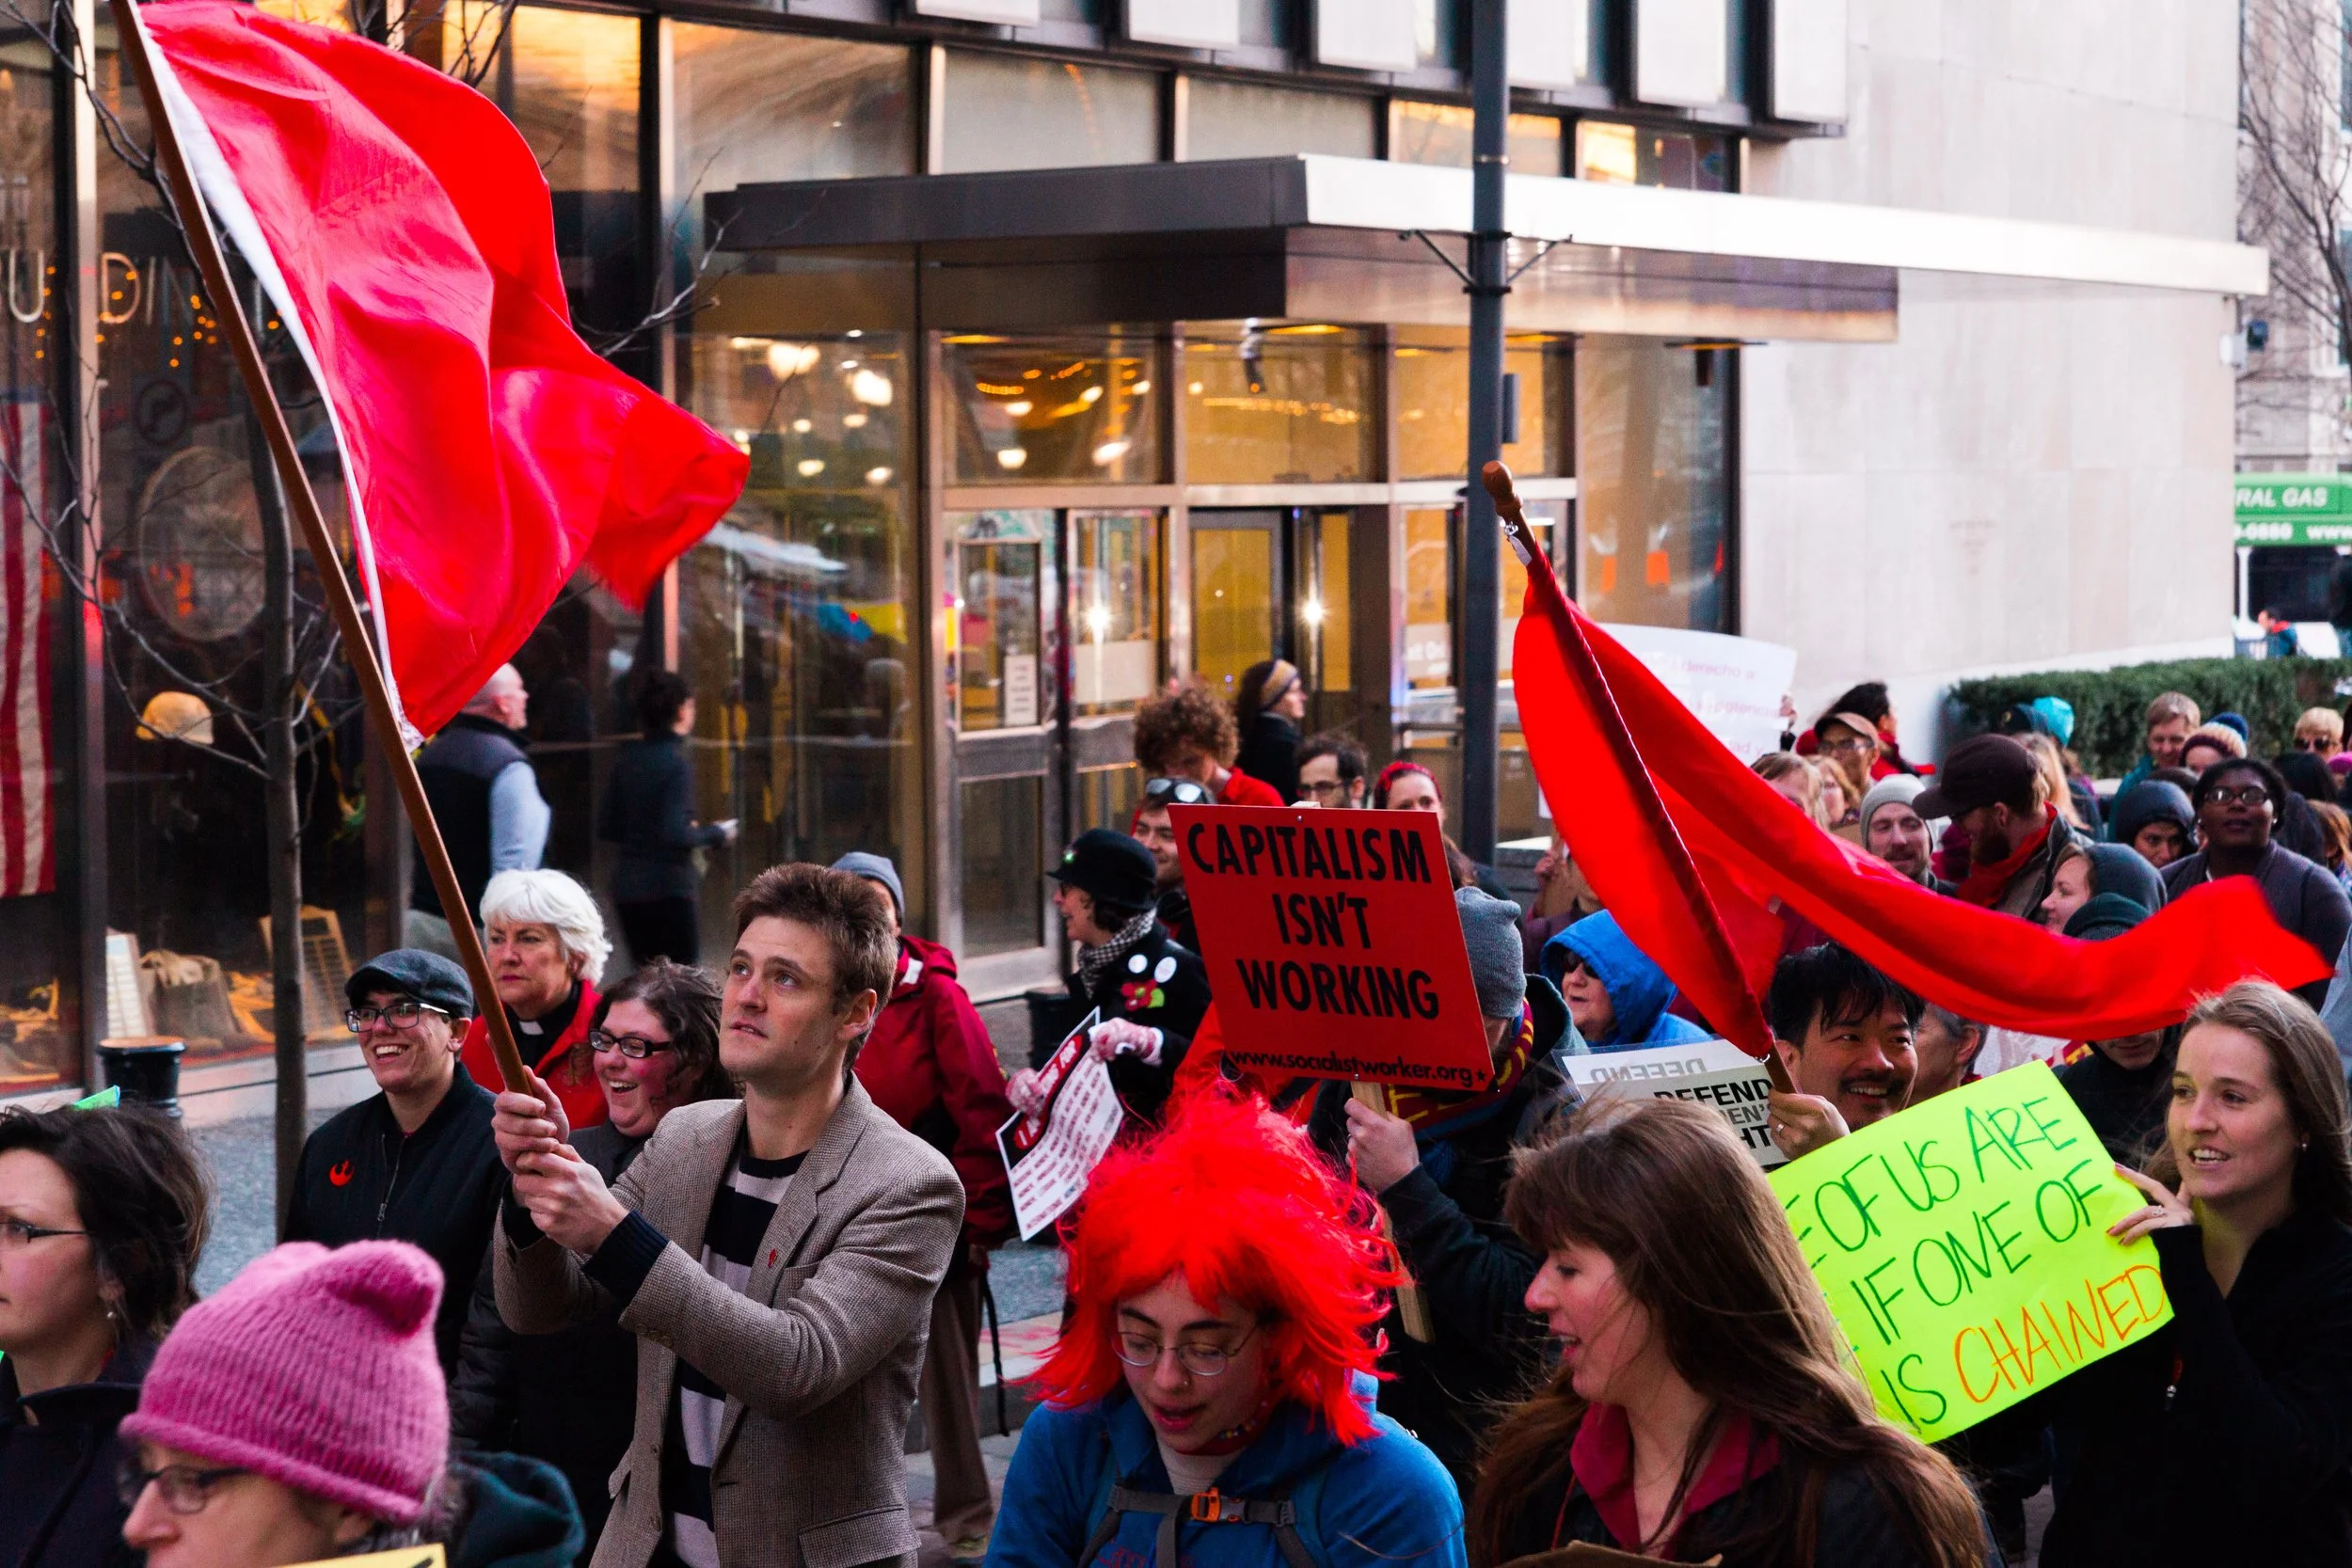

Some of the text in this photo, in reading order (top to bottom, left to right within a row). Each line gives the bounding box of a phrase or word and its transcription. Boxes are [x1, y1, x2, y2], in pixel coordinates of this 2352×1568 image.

[2281, 487, 2328, 508] GAS
[1187, 822, 1432, 883] CAPITALISM
[1271, 892, 1372, 950] ISN'T
[1235, 958, 1438, 1020] WORKING
[1231, 1051, 1472, 1087] www.socialistworker.org
[1815, 1154, 1881, 1252] OF
[1881, 1140, 1960, 1212] US
[1965, 1097, 2077, 1182] ARE
[1851, 1159, 2103, 1345] IF ONE OF
[1881, 1264, 2165, 1434] IS CHAINED
